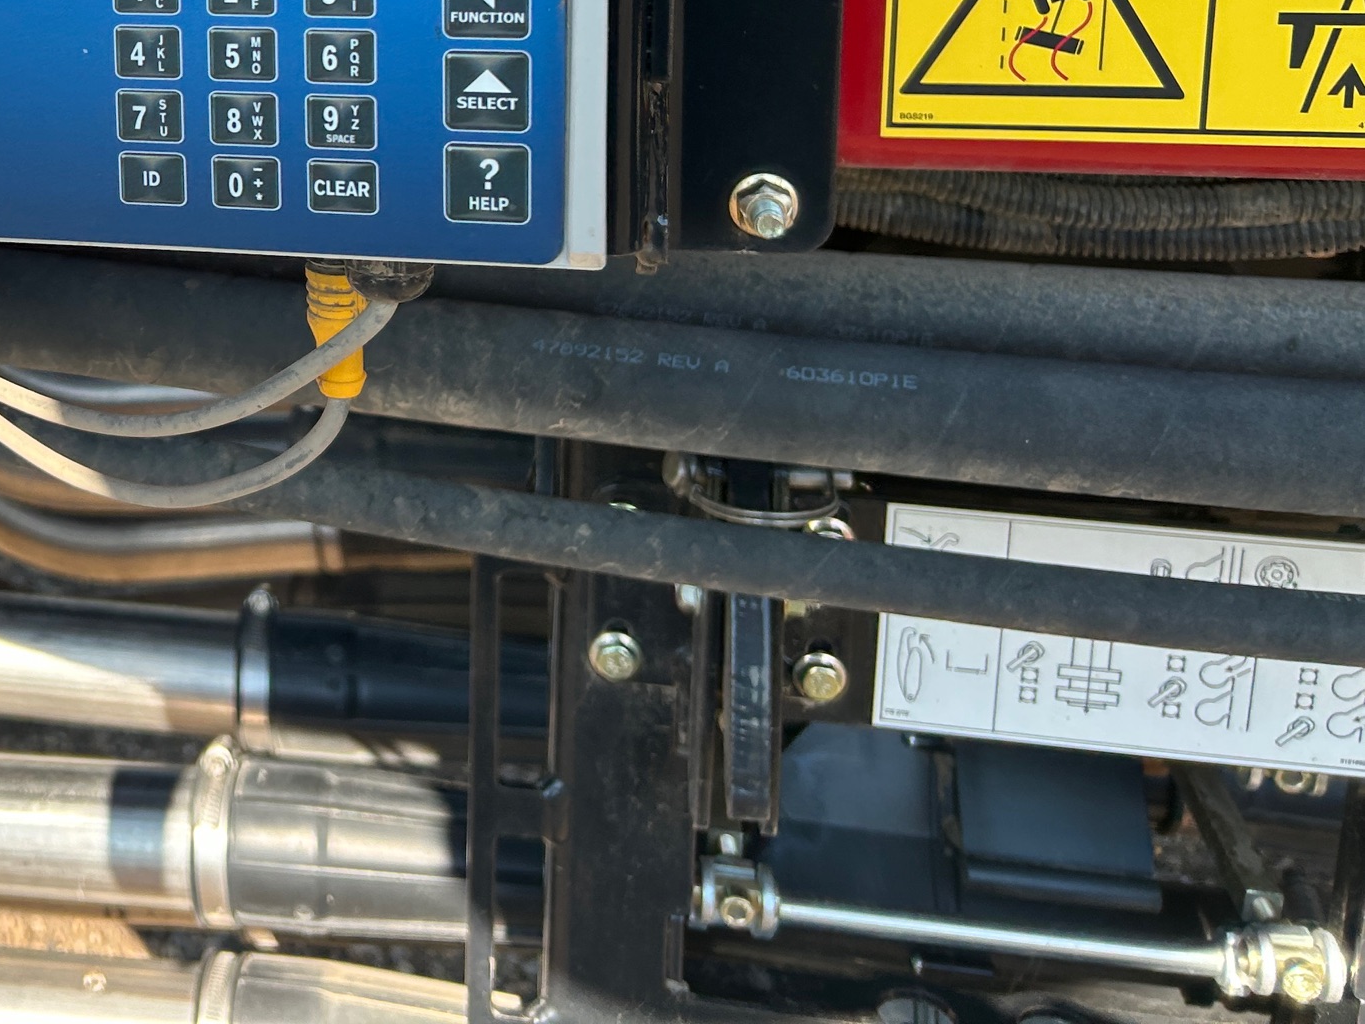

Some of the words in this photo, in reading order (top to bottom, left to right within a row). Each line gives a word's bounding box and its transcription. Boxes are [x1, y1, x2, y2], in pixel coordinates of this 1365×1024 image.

[450, 11, 525, 24] FUNCTION
[130, 41, 146, 67] 4
[225, 43, 240, 69] 5
[322, 44, 338, 71] 6
[456, 95, 518, 111] SELECT
[132, 105, 147, 130] 7
[226, 107, 242, 133] 8
[323, 105, 339, 132] 9
[325, 133, 356, 144] SPACE
[142, 170, 161, 187] ID
[228, 172, 244, 198] 0
[313, 178, 370, 198] CLEAR
[469, 196, 510, 212] HELP
